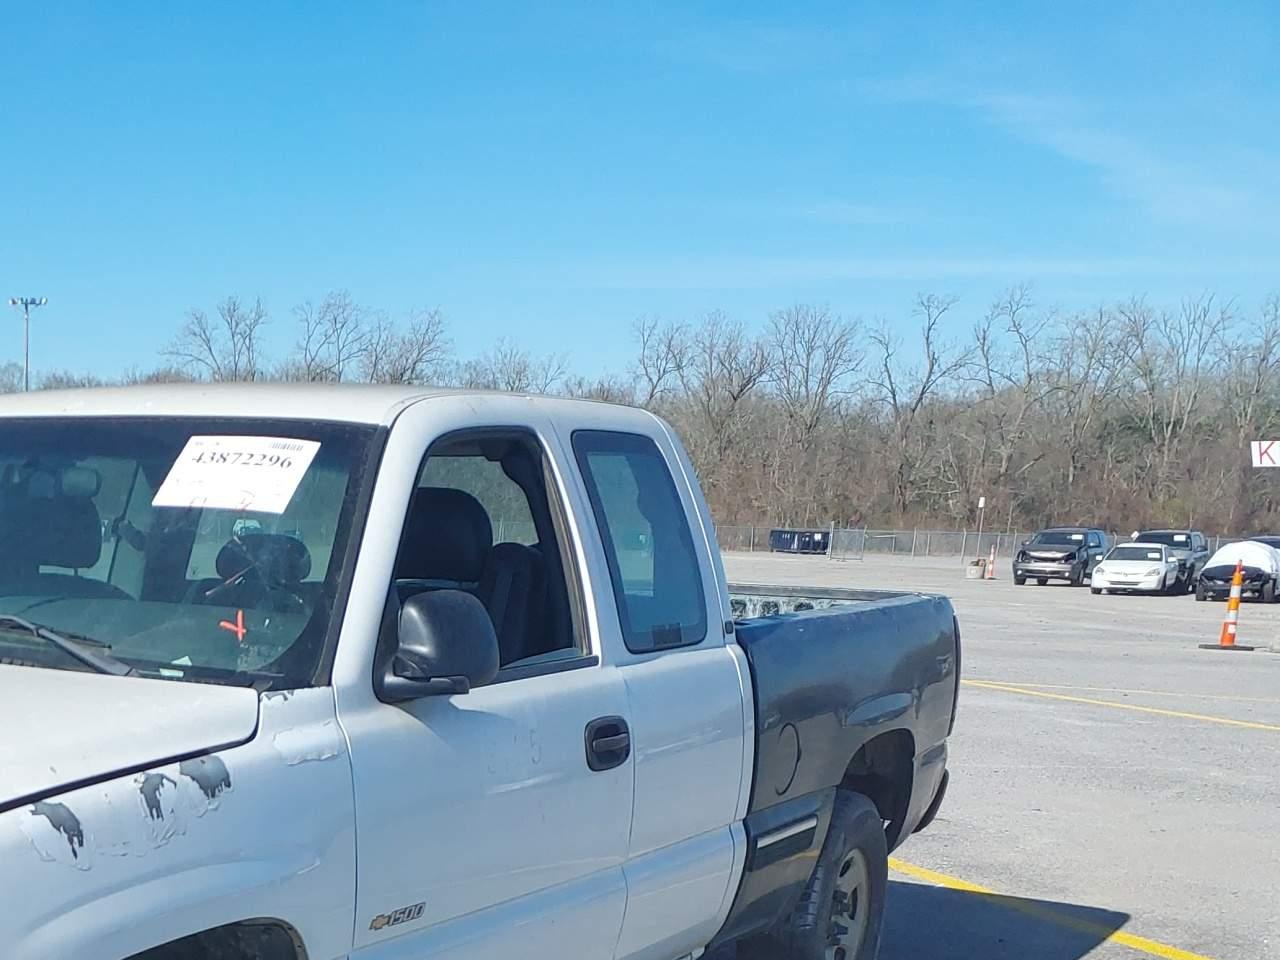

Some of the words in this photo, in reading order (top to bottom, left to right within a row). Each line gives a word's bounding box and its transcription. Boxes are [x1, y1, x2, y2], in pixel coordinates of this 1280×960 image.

[191, 451, 293, 470] 43872296
[1258, 441, 1276, 465] K
[388, 902, 426, 926] 1500
